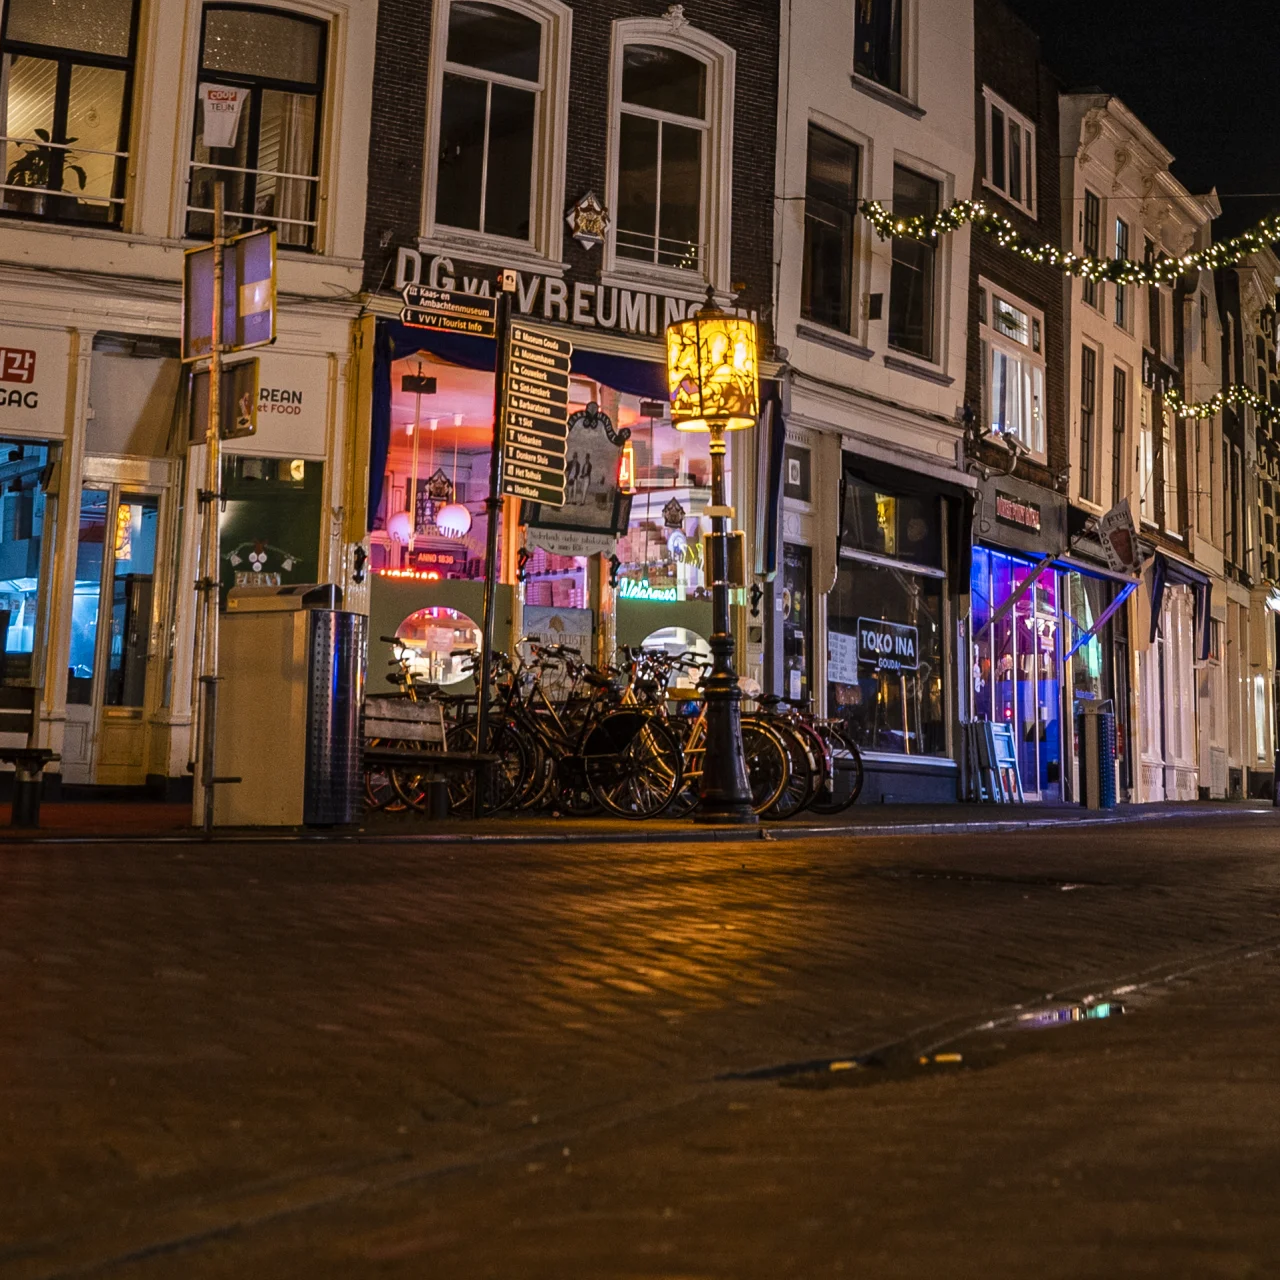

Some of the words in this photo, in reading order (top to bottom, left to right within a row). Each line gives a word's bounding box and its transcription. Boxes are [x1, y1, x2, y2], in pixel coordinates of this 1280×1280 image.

[440, 292, 450, 300] en
[420, 298, 490, 317] Ambachtenmuseum
[419, 314, 437, 324] VVV
[442, 316, 467, 330] Tourist
[468, 321, 483, 332] Info
[522, 332, 543, 346] Museum
[543, 338, 559, 350] Gouda
[258, 388, 303, 404] REAN
[271, 404, 302, 415] FOOD
[861, 630, 893, 654] TOKO
[895, 635, 915, 657] INA
